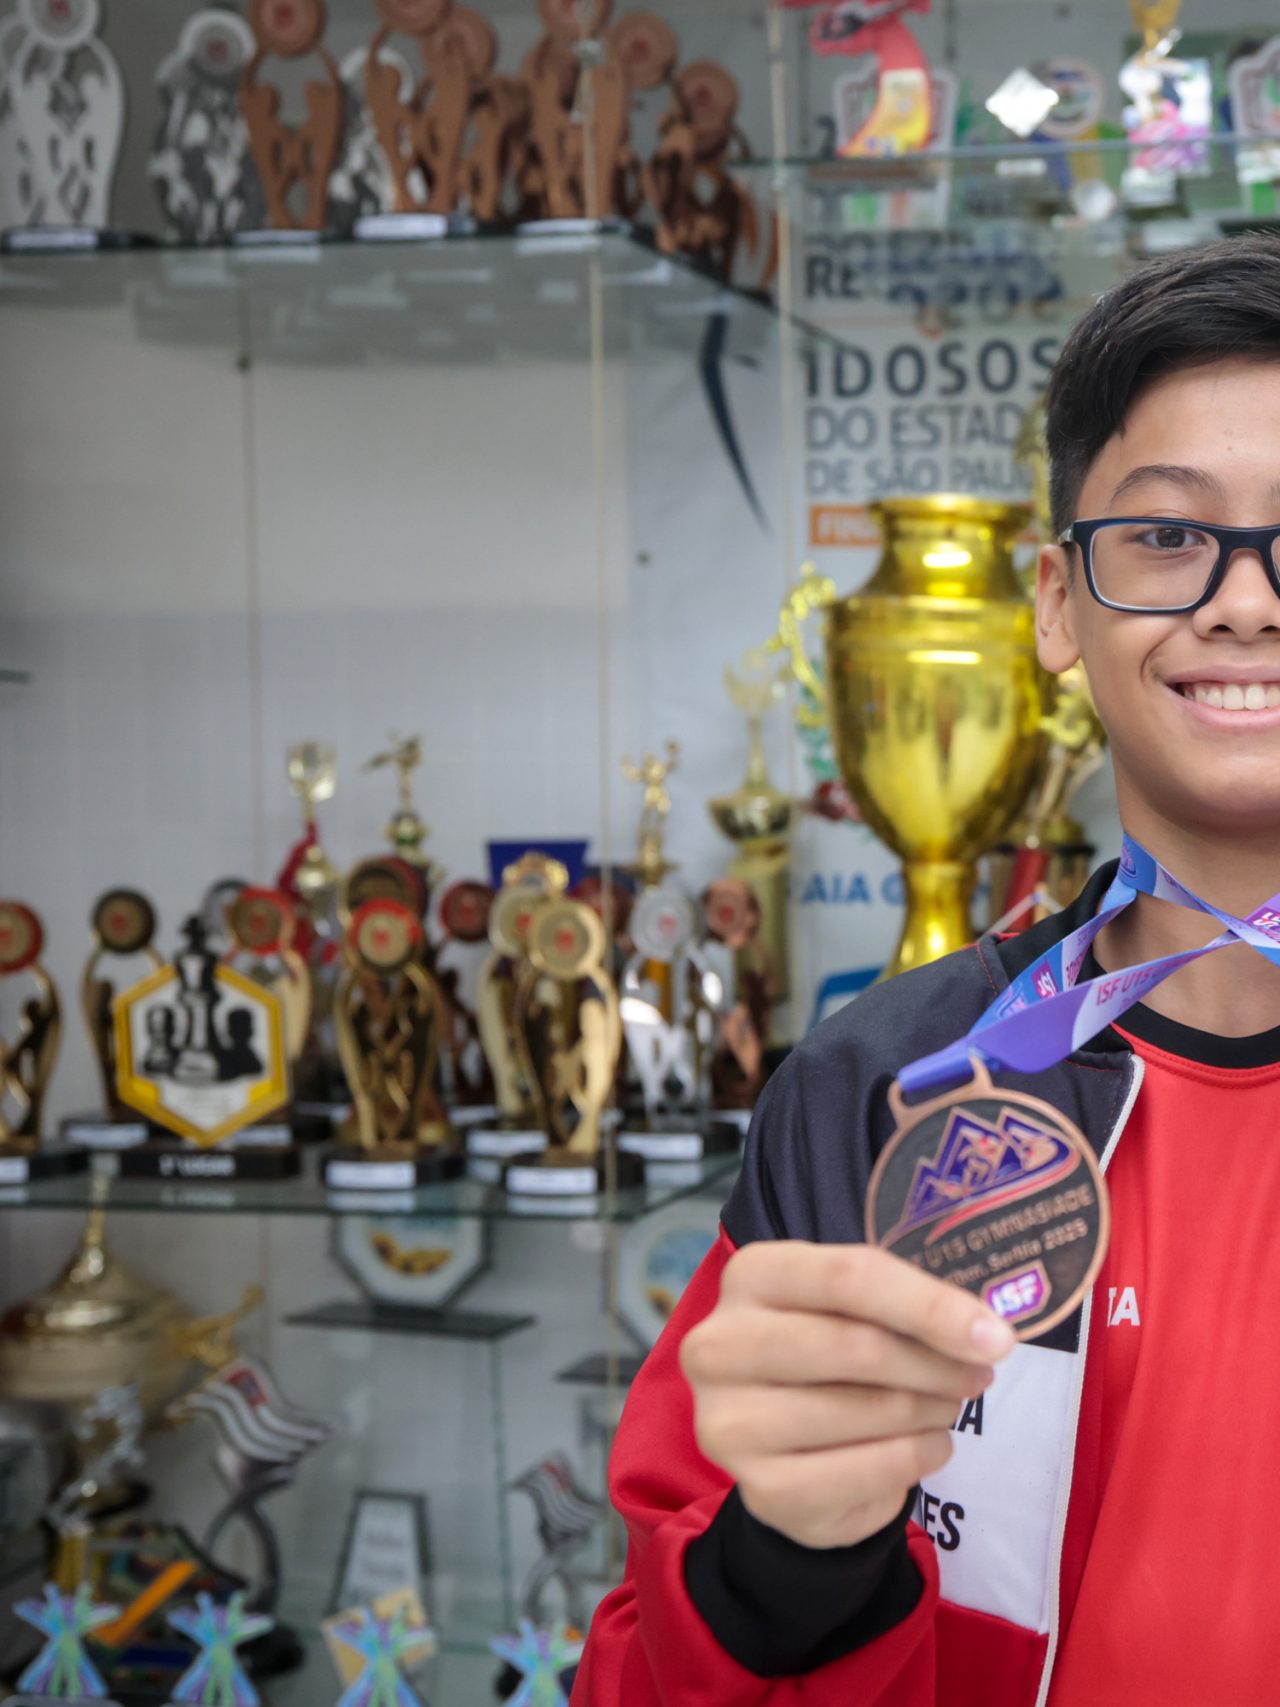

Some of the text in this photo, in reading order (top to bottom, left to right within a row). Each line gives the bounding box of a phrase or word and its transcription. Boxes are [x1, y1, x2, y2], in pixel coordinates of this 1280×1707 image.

[802, 336, 1060, 398] IDOSOS
[805, 403, 1025, 450] DO ESTAD
[805, 457, 853, 495] DE
[864, 450, 941, 494] SÃO
[800, 871, 871, 904] AIA
[1096, 978, 1121, 1006] ISF
[966, 1184, 1093, 1251] GYMNASIADE
[991, 1272, 1039, 1318] ISF
[921, 1488, 965, 1551] ES
